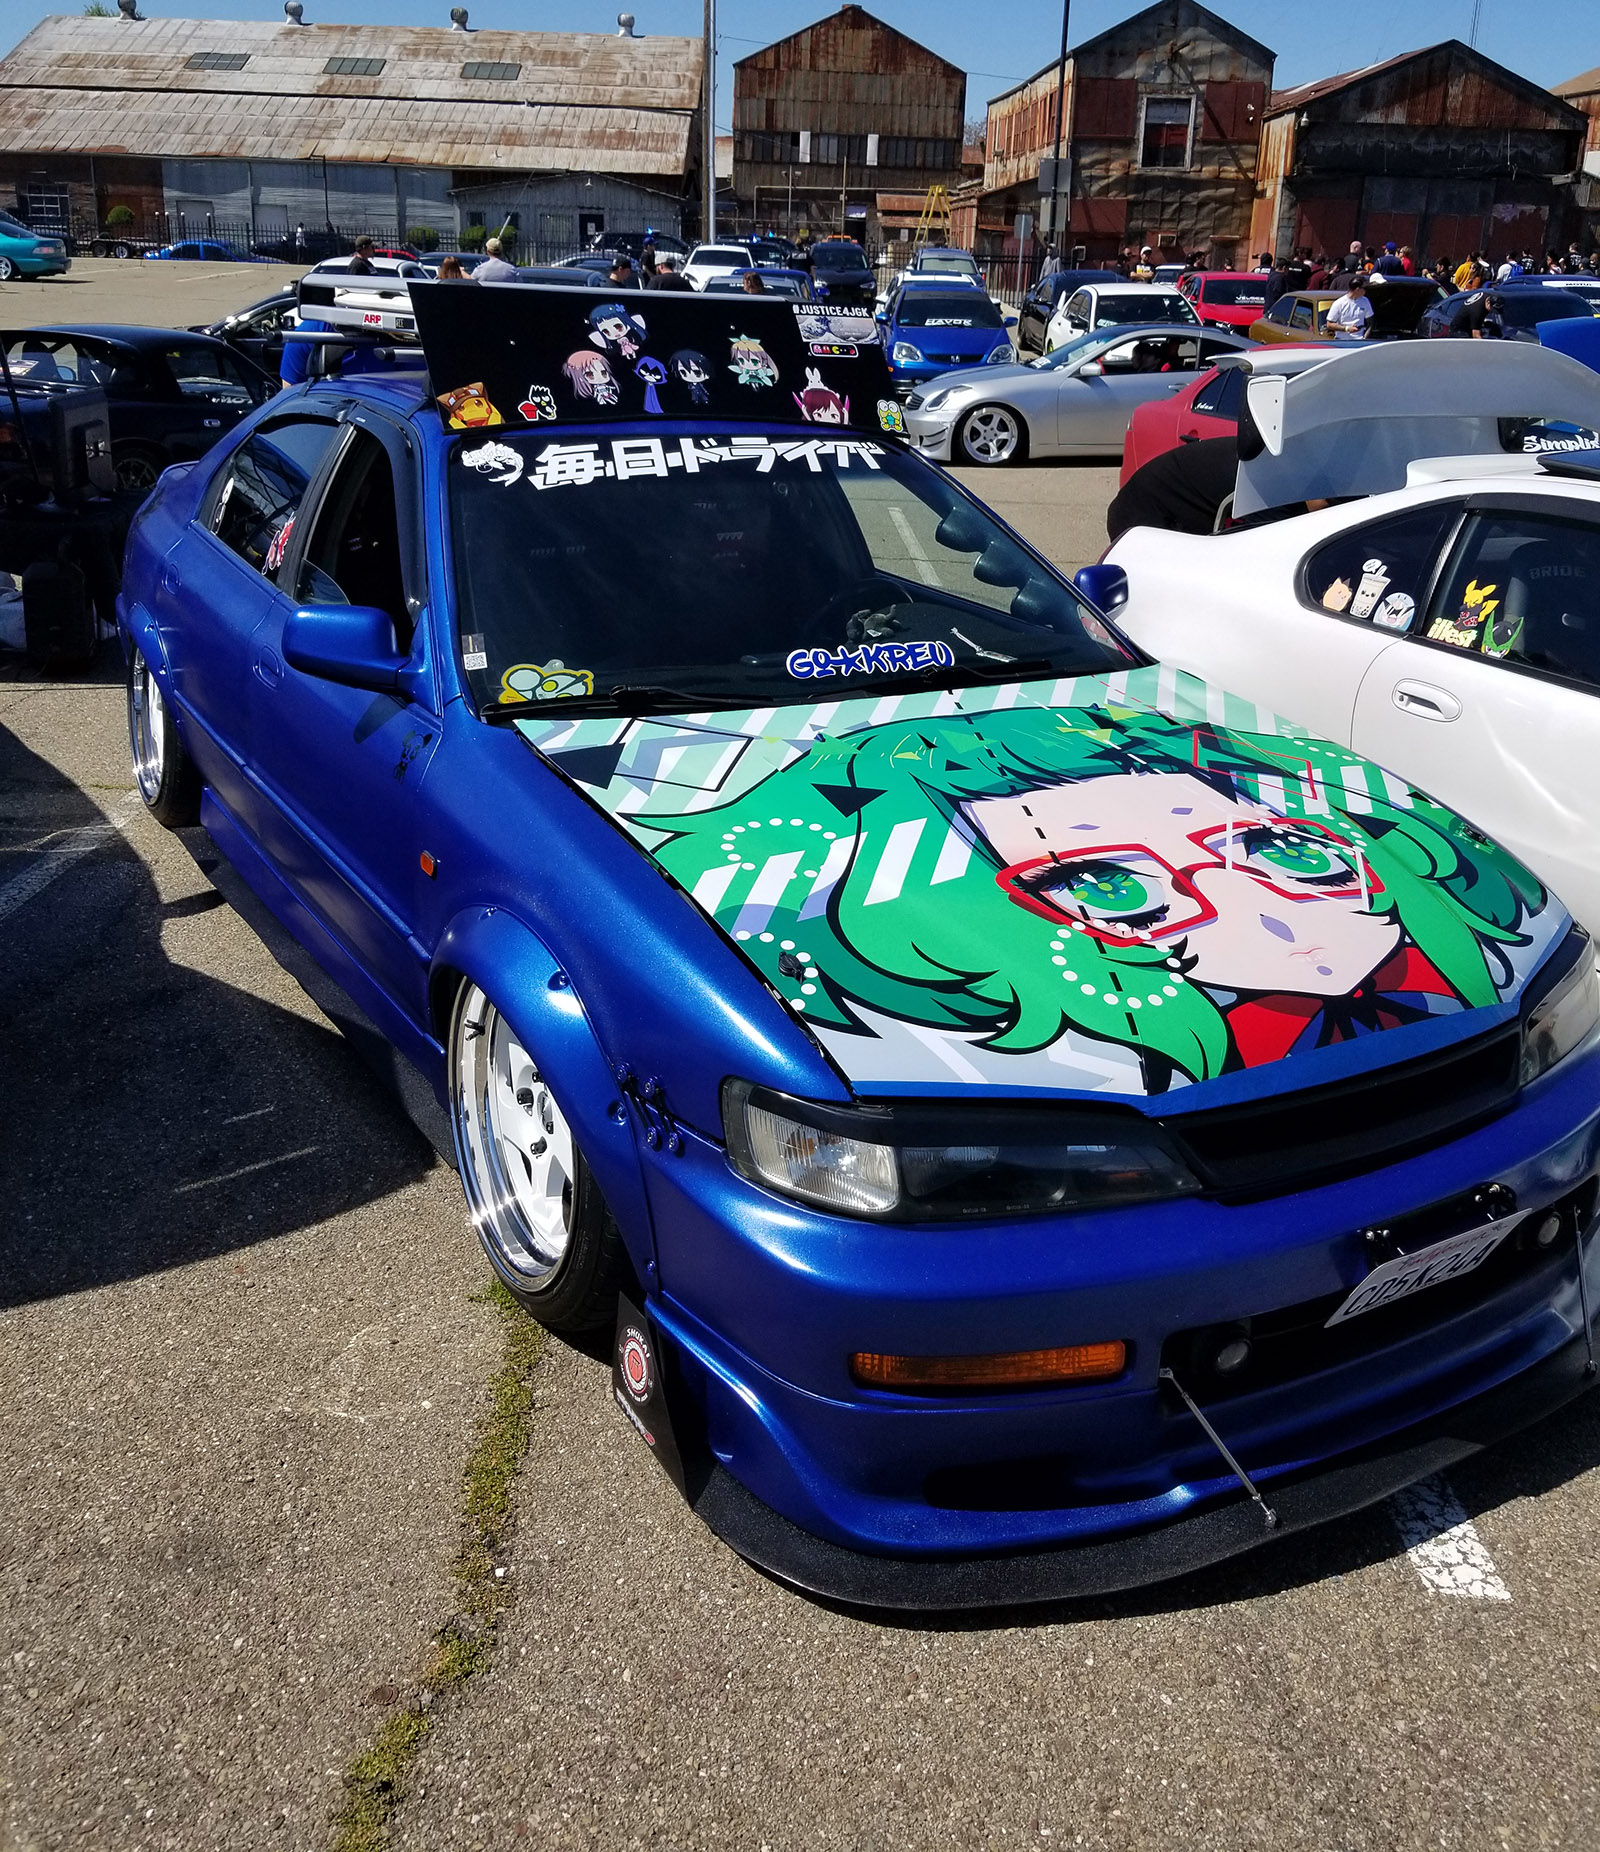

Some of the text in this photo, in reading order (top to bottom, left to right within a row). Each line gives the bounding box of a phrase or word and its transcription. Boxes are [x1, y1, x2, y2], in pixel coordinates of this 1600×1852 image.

[363, 313, 382, 324] ARP
[792, 303, 870, 318] #JUSTICE4JGK
[1528, 564, 1587, 580] BRIDE
[1426, 616, 1479, 649] illest
[626, 1327, 651, 1359] SHOKAI
